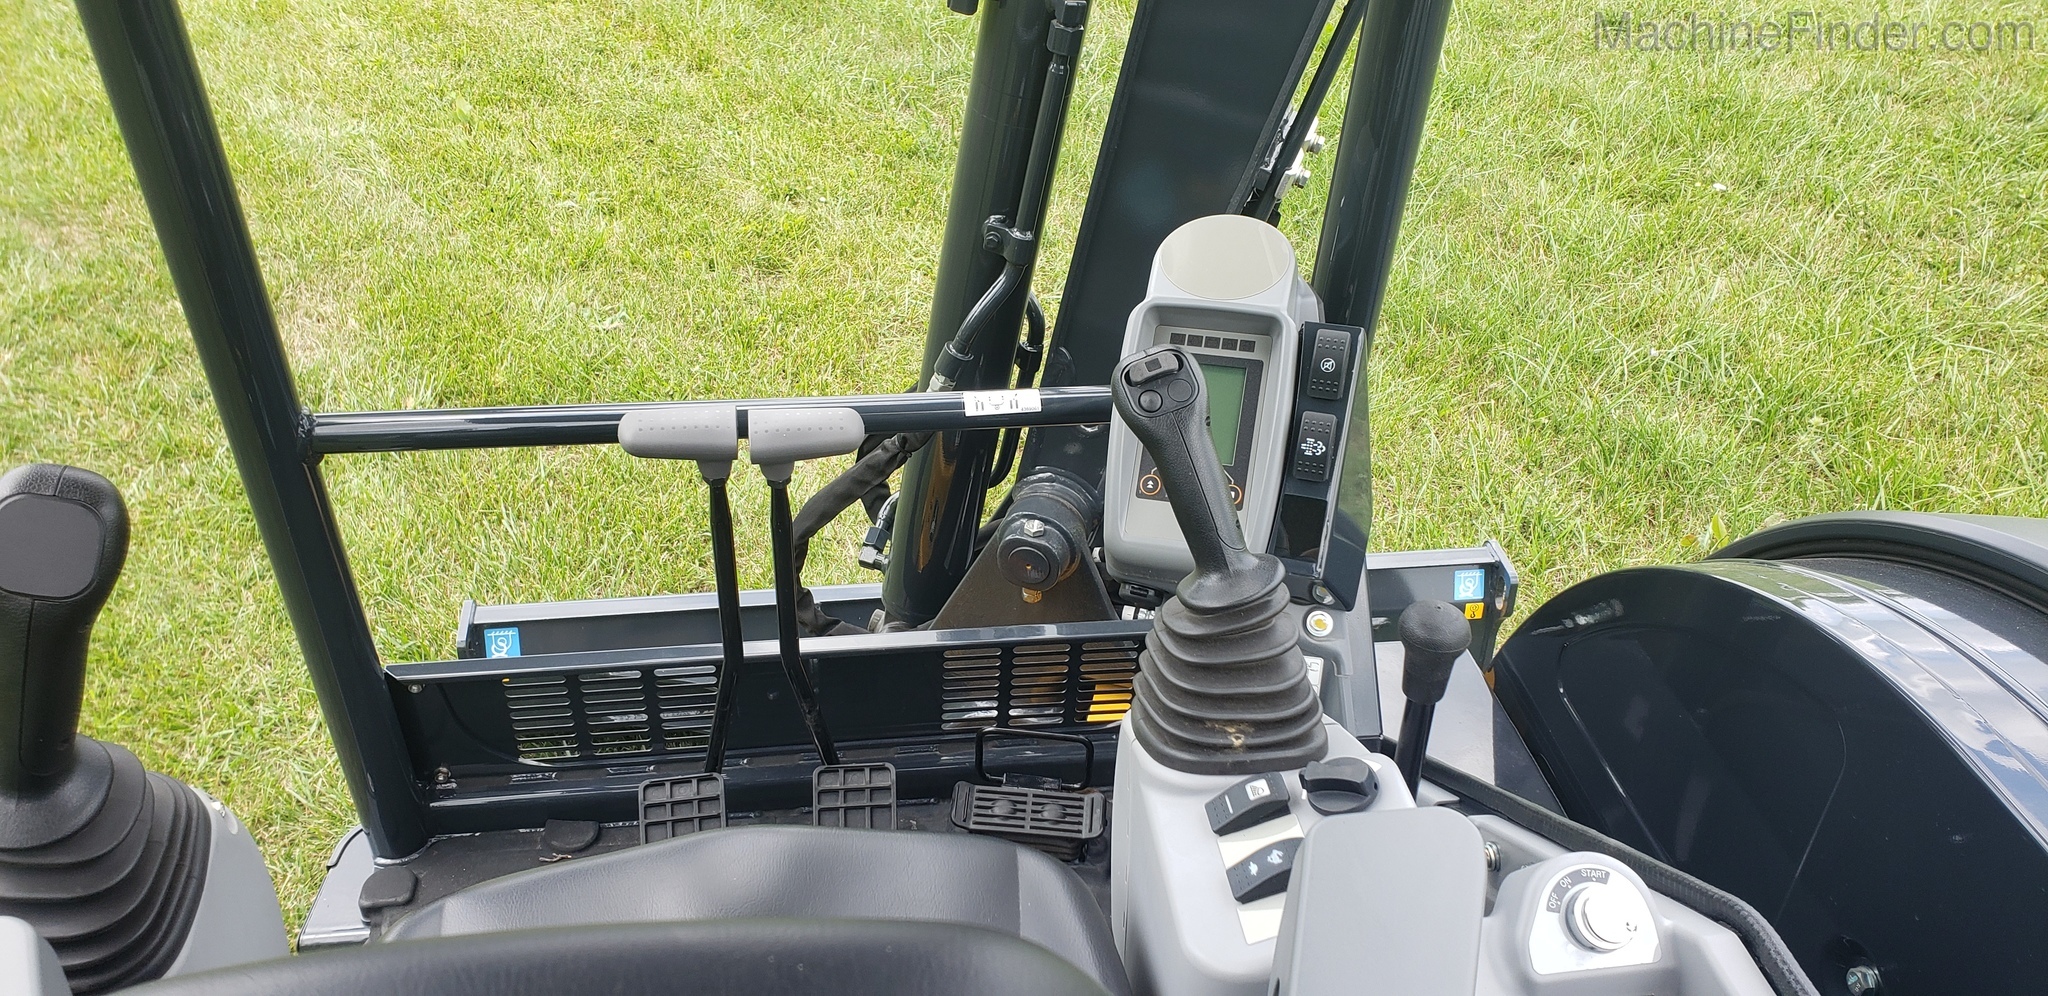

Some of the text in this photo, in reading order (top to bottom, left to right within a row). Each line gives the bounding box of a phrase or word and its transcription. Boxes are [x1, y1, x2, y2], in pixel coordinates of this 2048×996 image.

[1581, 869, 1607, 879] START
[1560, 876, 1572, 888] ON
[1548, 892, 1559, 909] OFF
